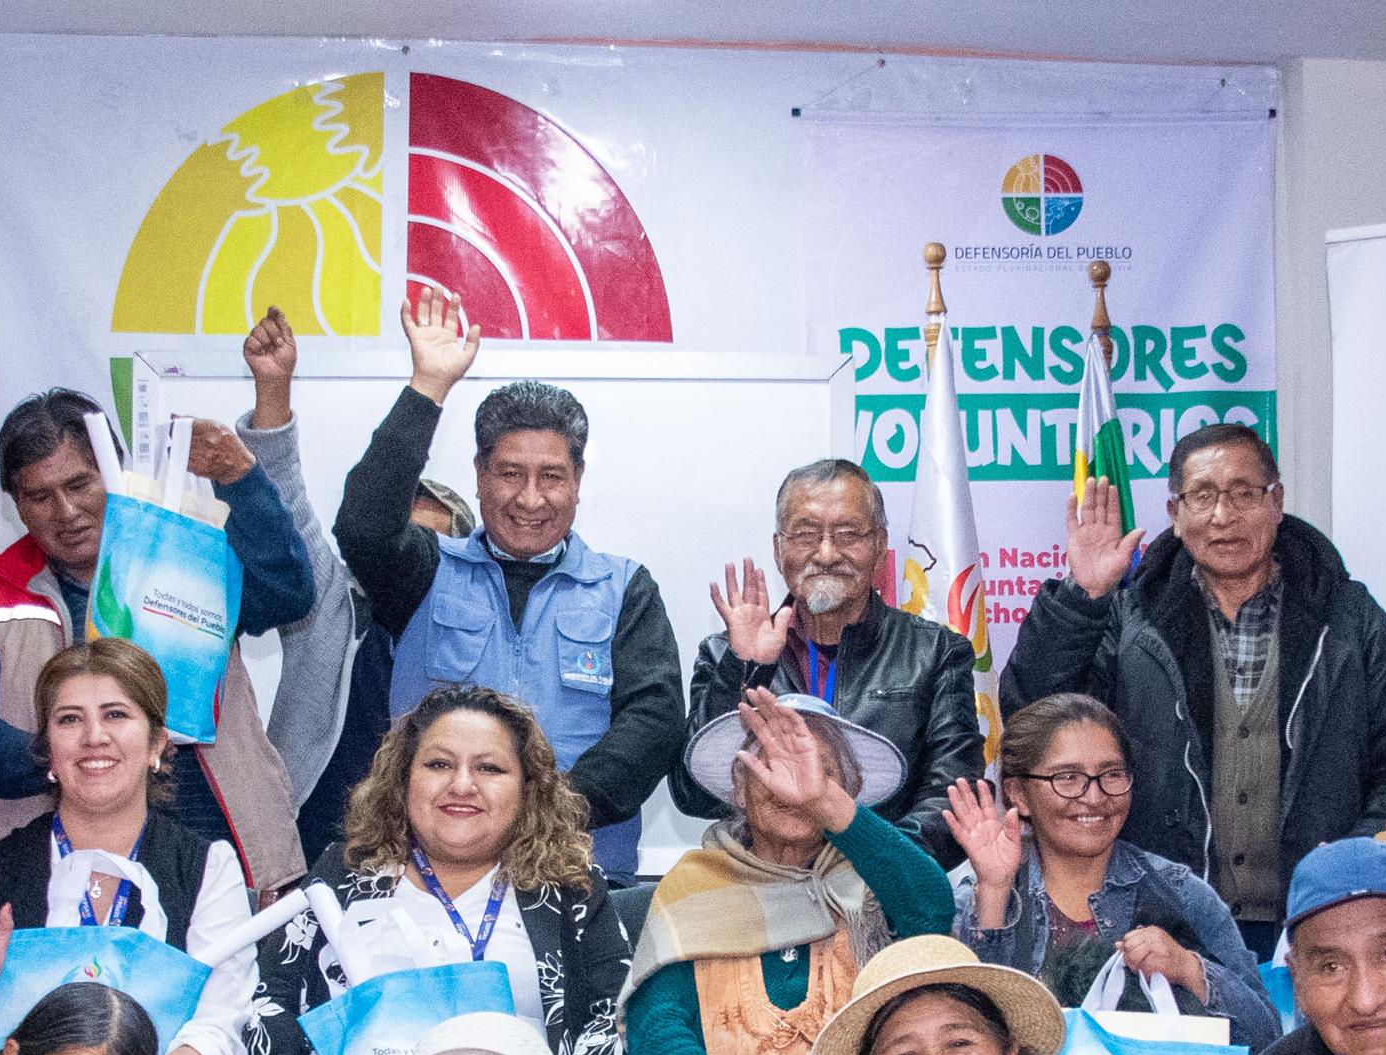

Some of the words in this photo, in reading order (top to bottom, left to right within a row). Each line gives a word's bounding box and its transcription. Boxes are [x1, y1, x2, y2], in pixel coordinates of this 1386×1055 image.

[955, 243, 1043, 259] DEFENSORÍA
[1047, 247, 1070, 259] DEL
[1077, 247, 1132, 259] PUEBLO
